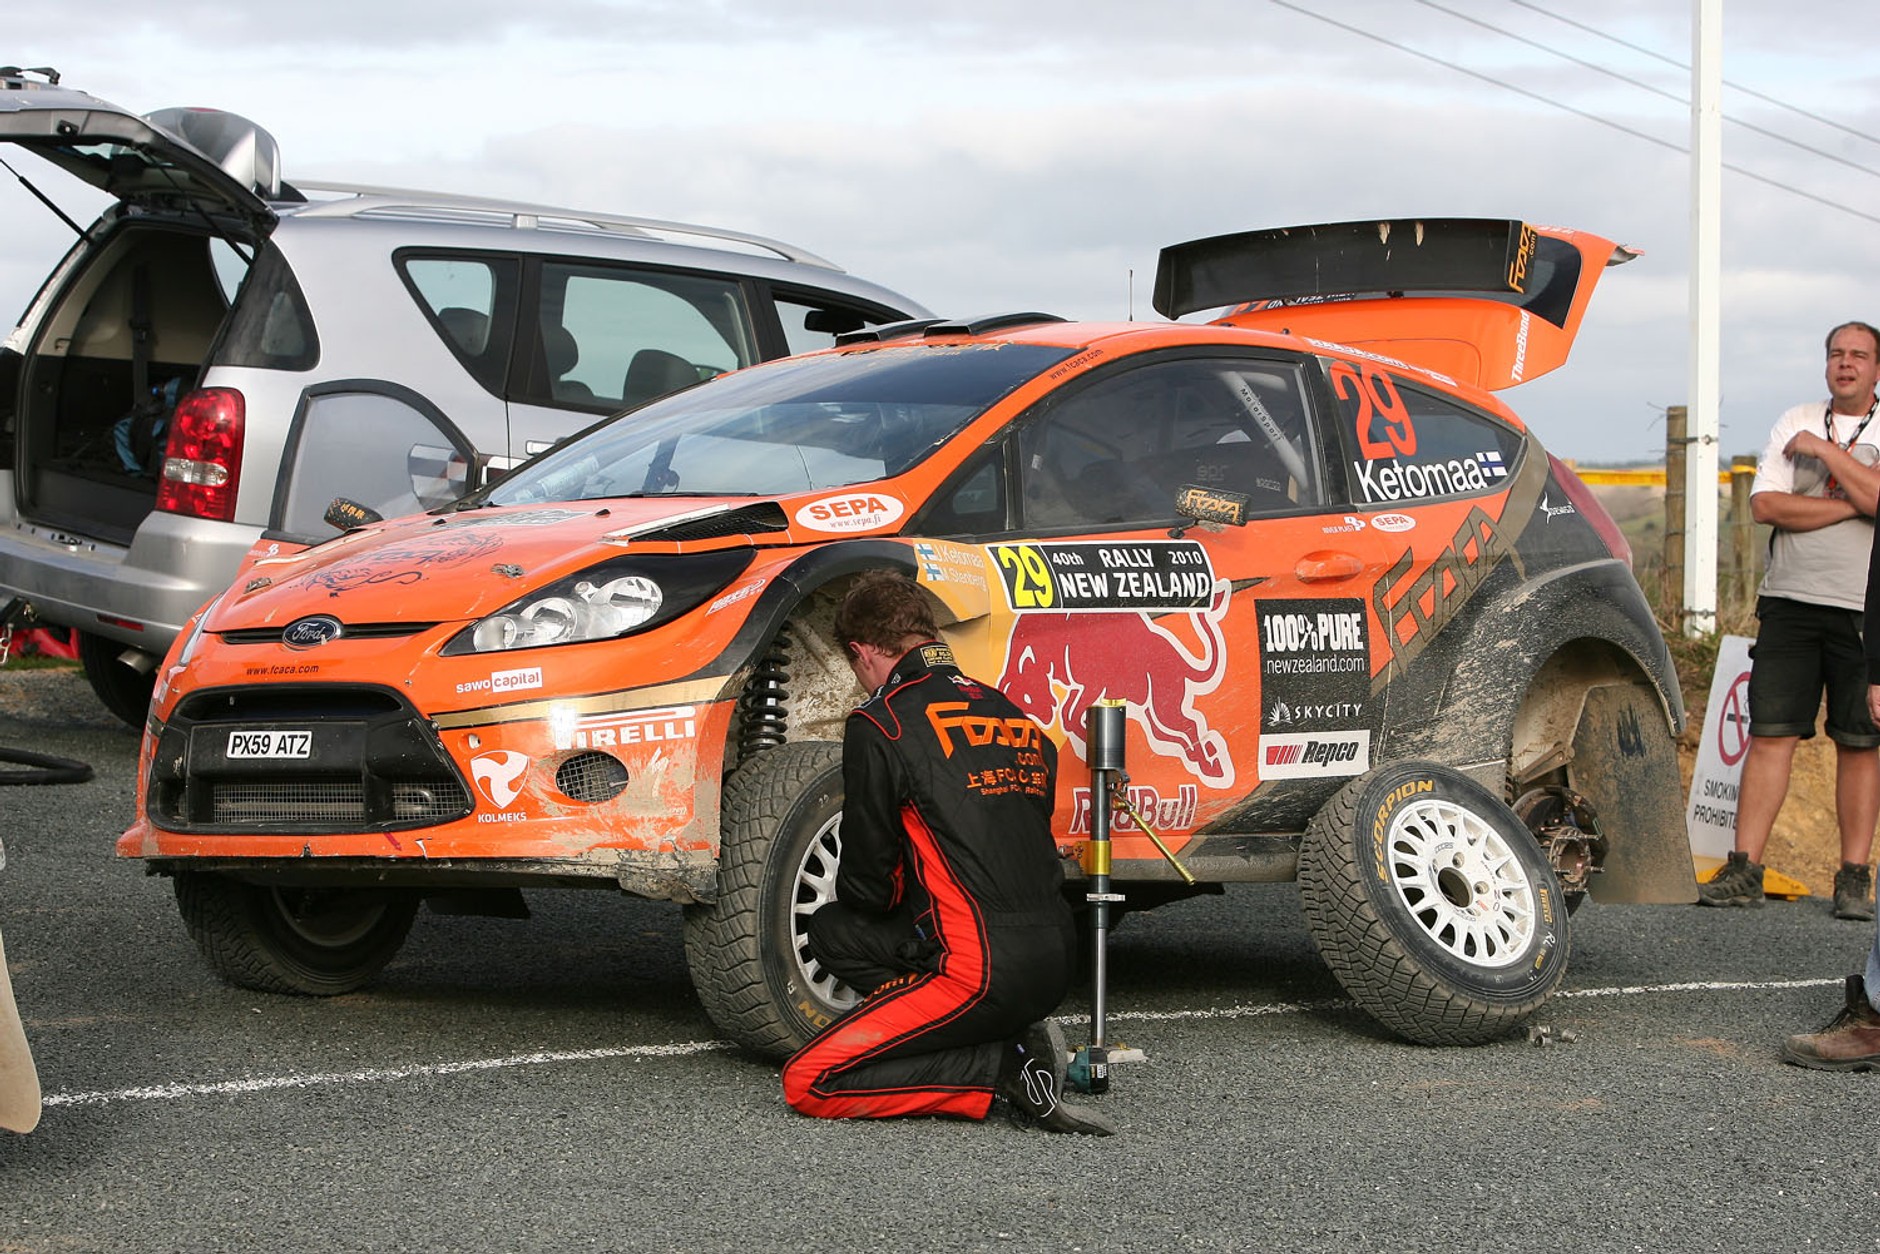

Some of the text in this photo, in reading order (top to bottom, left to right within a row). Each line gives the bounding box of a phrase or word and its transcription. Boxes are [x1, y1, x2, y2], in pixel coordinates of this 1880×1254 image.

[1511, 309, 1530, 383] ThreeBond
[1331, 362, 1417, 460] 29
[1354, 459, 1488, 502] Ketomaa
[809, 497, 888, 521] SEPA
[829, 513, 881, 528] www.sepa.fi
[1376, 516, 1409, 526] SEPA
[1053, 549, 1202, 568] 40th RALLY 2010
[998, 545, 1053, 608] 29
[1058, 572, 1210, 598] NEW ZEALAND
[292, 622, 324, 640] Ford
[1317, 613, 1364, 651] PURE
[246, 664, 319, 675] www.fcaca.com
[1266, 655, 1365, 674] newzealand.com
[456, 672, 540, 693] sawo capital
[1295, 704, 1362, 719] SKYCITY
[553, 706, 696, 750] PIRELLI
[230, 735, 310, 755] PX59 ATZ
[1301, 741, 1359, 767] Repco
[1704, 780, 1739, 802] SMOKIN
[478, 812, 527, 823] KOLMEKS
[1373, 780, 1433, 883] SCORPION
